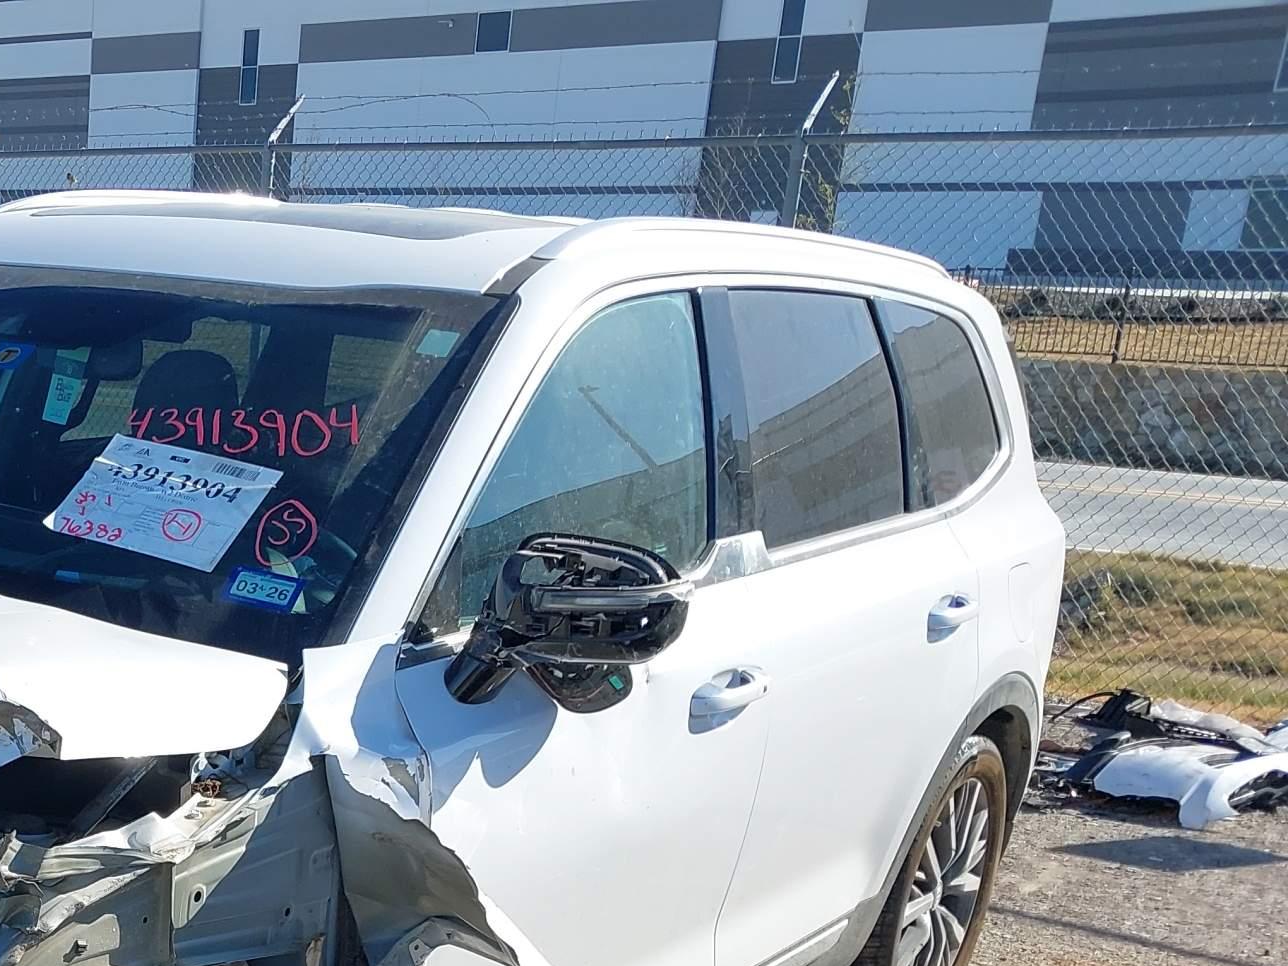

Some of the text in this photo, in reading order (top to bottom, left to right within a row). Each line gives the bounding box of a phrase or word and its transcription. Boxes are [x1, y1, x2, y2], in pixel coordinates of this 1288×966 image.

[128, 404, 360, 457] 43913904
[109, 463, 242, 503] 43913904
[60, 516, 122, 541] 76382
[236, 579, 290, 601] 03 26
